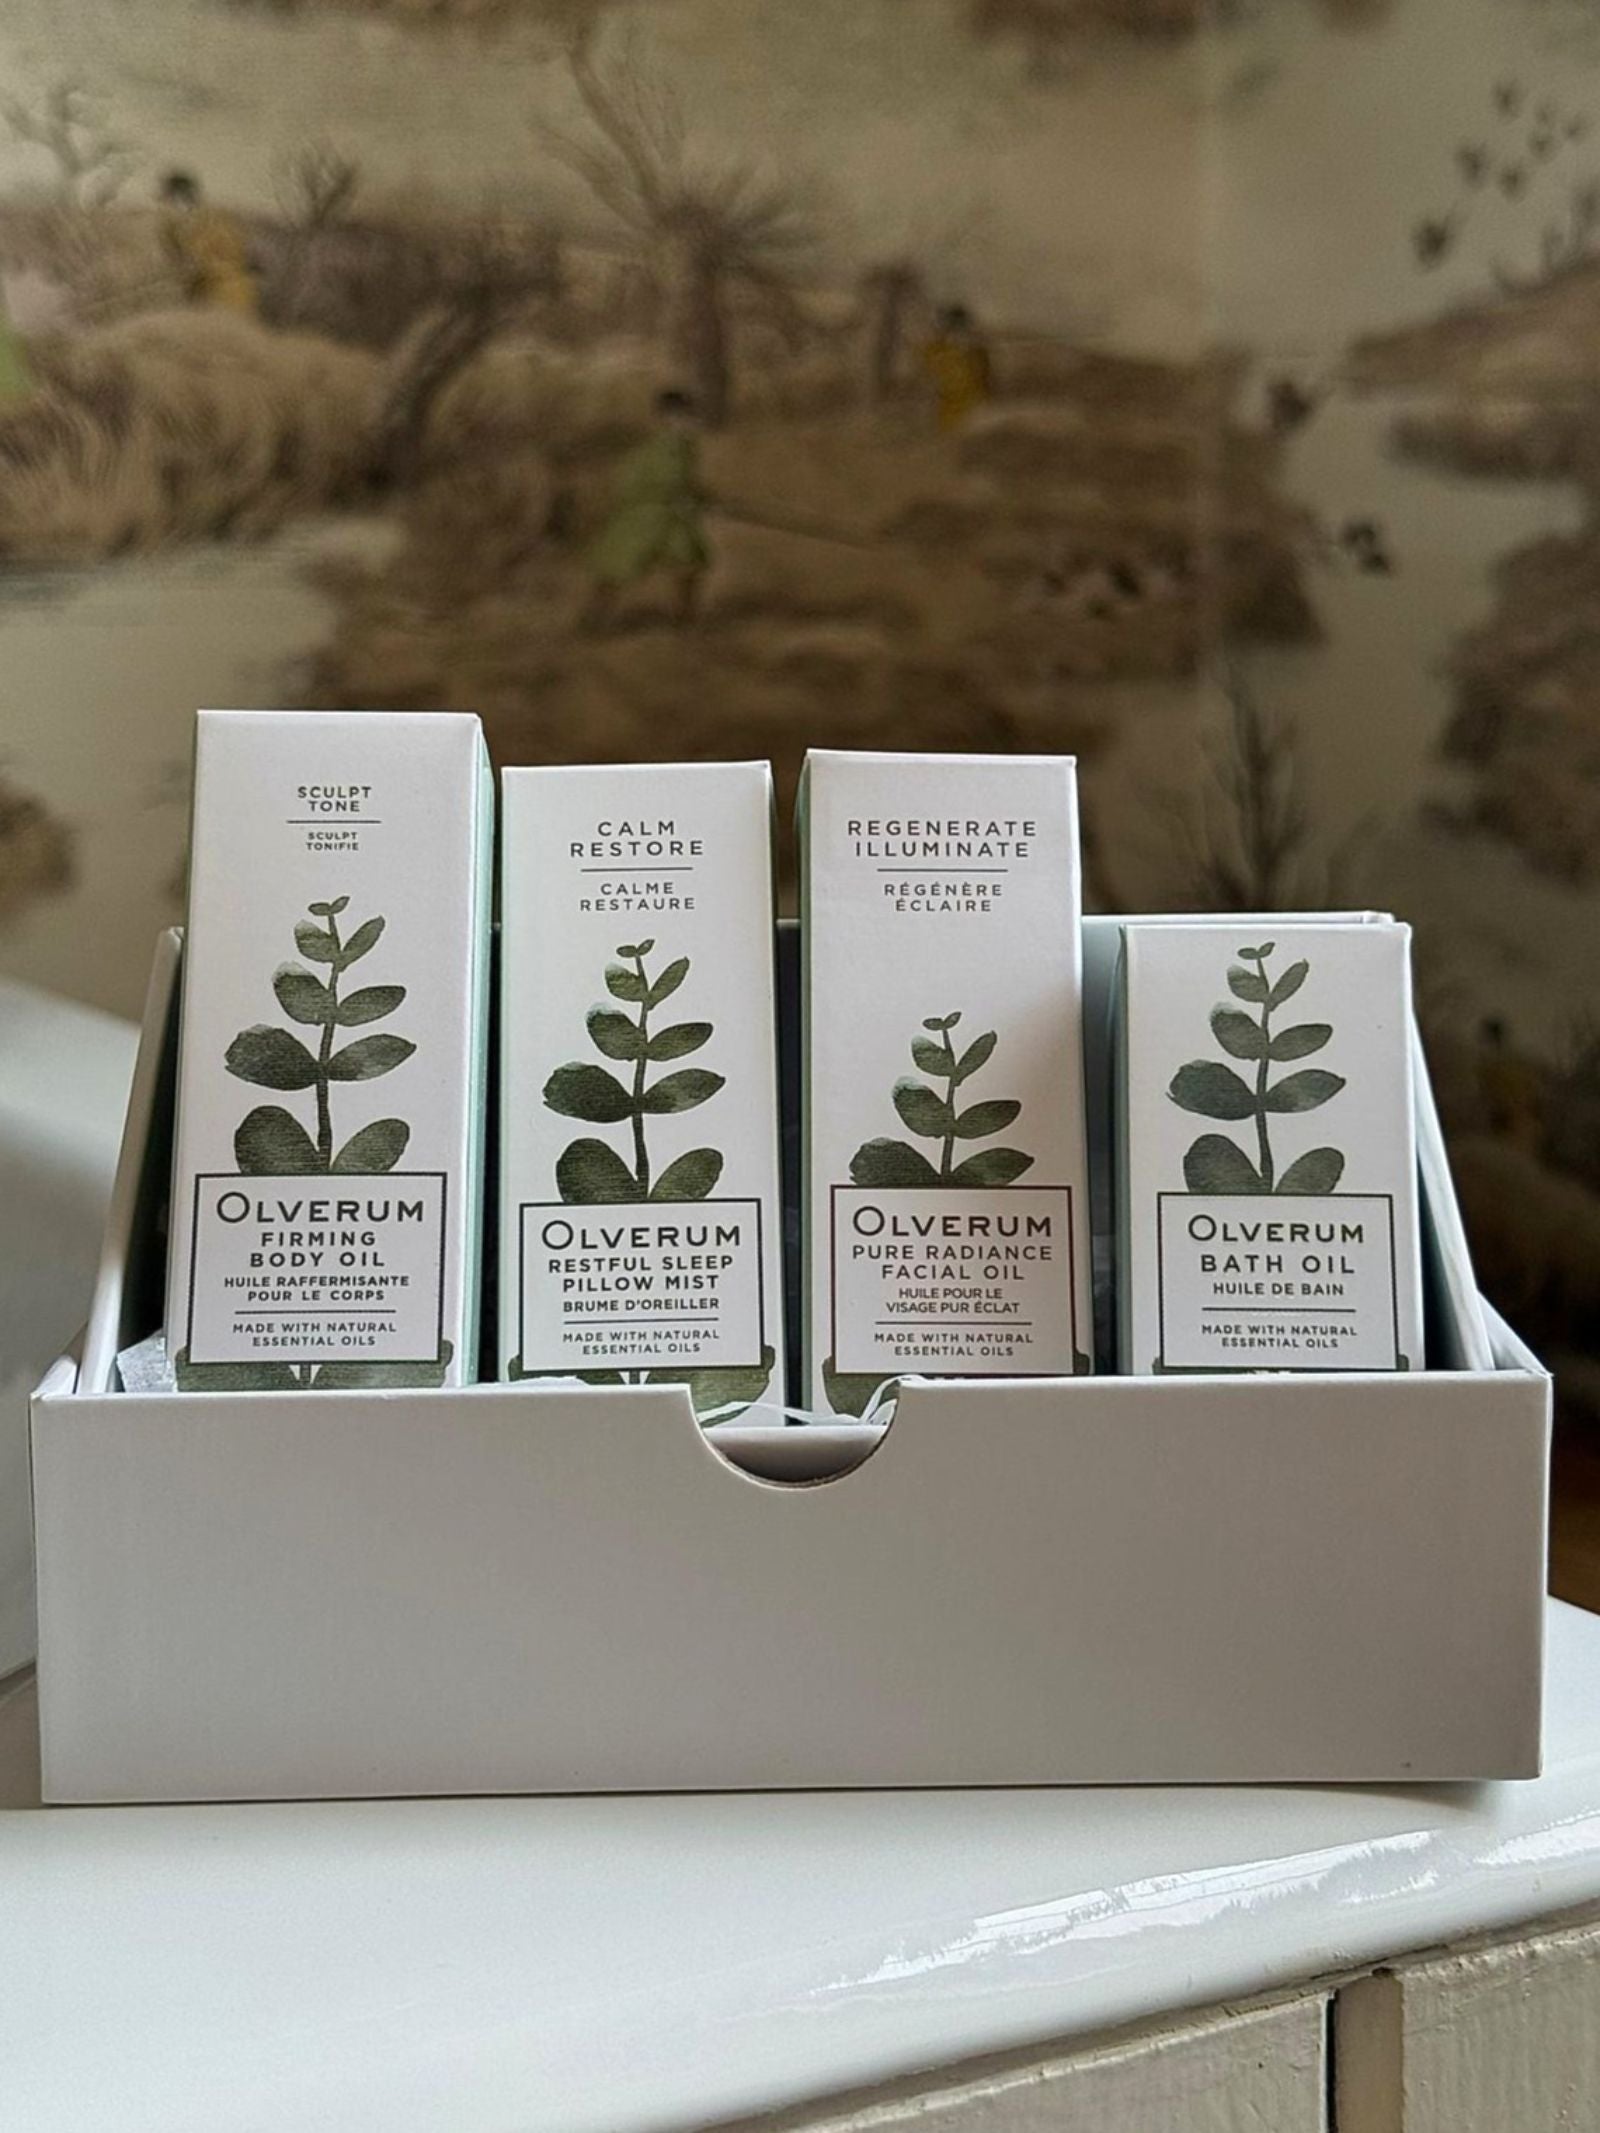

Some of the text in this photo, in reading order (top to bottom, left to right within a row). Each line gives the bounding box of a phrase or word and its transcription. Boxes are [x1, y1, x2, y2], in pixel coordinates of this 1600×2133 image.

[298, 786, 372, 798] SCULPT
[309, 800, 360, 812] TONE
[598, 821, 674, 837] CALM
[848, 820, 1036, 836] REGENERATE
[308, 832, 357, 840] SCULPT
[306, 842, 359, 850] TONIFIE
[570, 840, 703, 857] RESTORE
[855, 842, 1029, 857] ILLUMINATE
[600, 882, 674, 895] CALME
[884, 882, 1002, 896] RÉGÉNÈRE
[580, 898, 695, 911] RESTAURE
[896, 898, 991, 912] ÉCLAIRE
[261, 1232, 376, 1247] FIRMING
[853, 1245, 1052, 1260] PURE RADIANCE
[250, 1251, 385, 1268] BODY OIL
[549, 1255, 733, 1273] RESTFUL SLEEP
[1201, 1255, 1355, 1274] BATH OIL
[882, 1264, 1024, 1280] FACIAL OIL
[224, 1276, 409, 1288] HUILE RAFFERMISANTE
[563, 1275, 719, 1292] PILLOW MIST
[248, 1290, 385, 1301] POUR LE CORPS
[899, 1288, 1002, 1299] HUILE POUR LE
[1213, 1283, 1343, 1296] HUILE DE BAIN
[563, 1298, 720, 1312] BRUME D'OREILLER
[887, 1301, 1020, 1313] VISAGE PUR ÉCLAT
[233, 1322, 397, 1333] MADE WITH NATURAL
[1202, 1325, 1357, 1336] MADE WITH NATURAL
[253, 1336, 375, 1346] ESSENTIAL OILS
[563, 1330, 720, 1342] MADE WITH NATURAL
[874, 1333, 1033, 1343] MADE WITH NATURAL
[583, 1343, 700, 1355] ESSENTIAL OILS
[1222, 1338, 1338, 1348] ESSENTIAL OILS
[895, 1347, 1013, 1356] ESSENTIAL OILS
